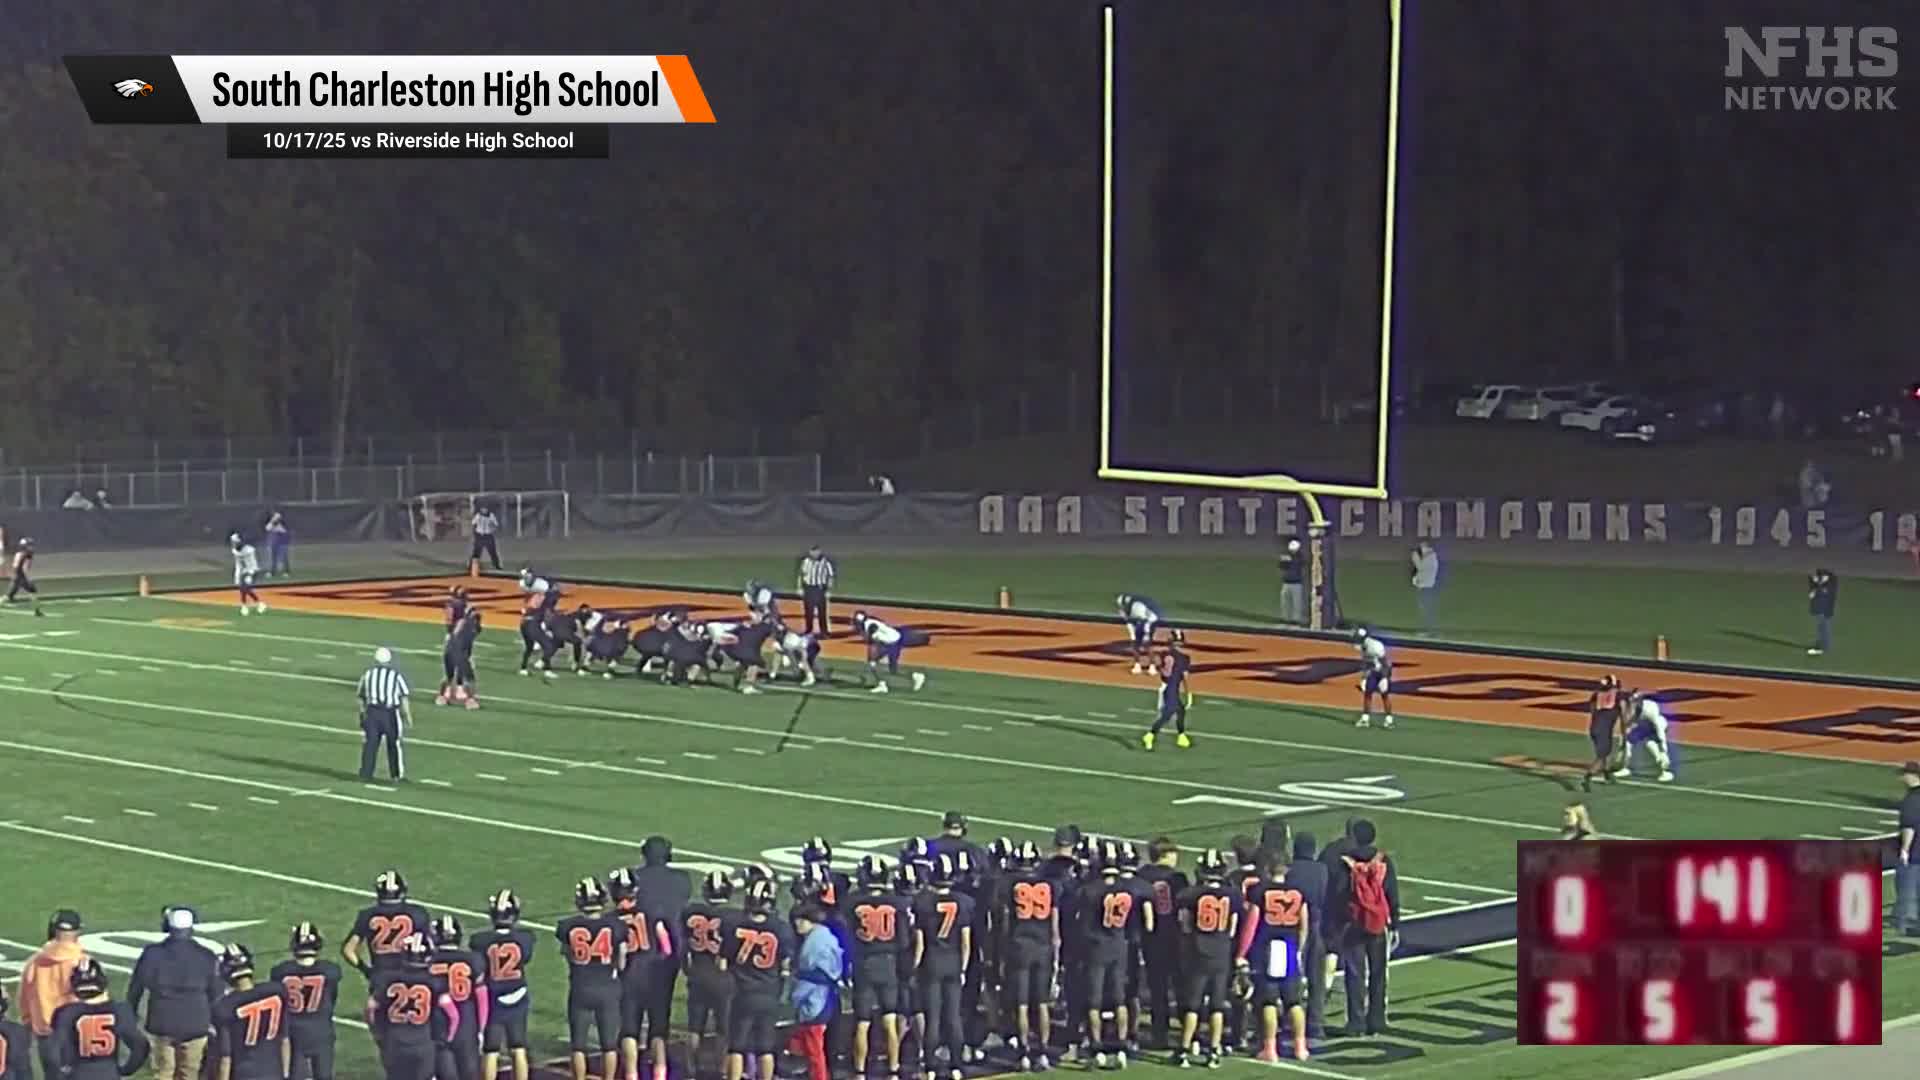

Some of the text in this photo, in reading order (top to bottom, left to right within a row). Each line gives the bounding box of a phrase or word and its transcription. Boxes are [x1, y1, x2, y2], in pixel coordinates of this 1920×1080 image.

[979, 496, 1081, 534] AAA
[1124, 497, 1297, 537] STATE
[1340, 500, 1667, 543] CHAMPIONS
[1709, 506, 1827, 548] 1945
[936, 901, 958, 939] 7
[1014, 881, 1052, 920] 99
[1197, 894, 1230, 932] 61
[1264, 889, 1303, 926] 52
[370, 914, 414, 953] 22
[854, 904, 897, 942] 30
[487, 942, 522, 981] 12
[569, 926, 613, 966] 64
[735, 926, 779, 970] 73
[236, 993, 282, 1046] 77
[386, 982, 431, 1025] 23
[76, 1012, 117, 1058] 15
